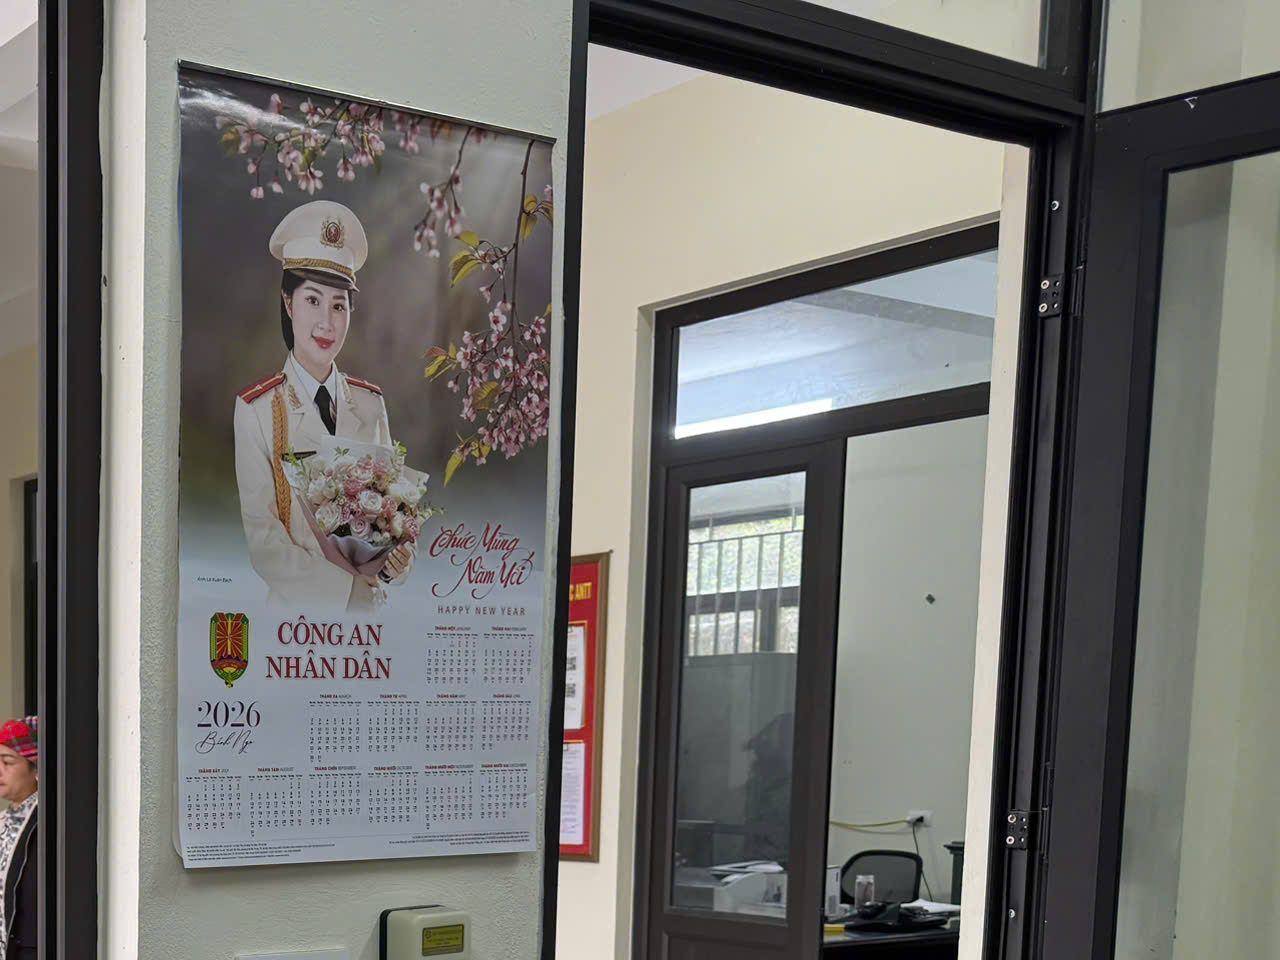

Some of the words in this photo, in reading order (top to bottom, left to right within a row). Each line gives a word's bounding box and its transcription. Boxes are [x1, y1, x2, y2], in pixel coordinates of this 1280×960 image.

[437, 605, 470, 615] HAPPY
[475, 606, 497, 616] NEW
[501, 607, 526, 616] YEAR
[277, 615, 344, 646] CÔNG
[348, 623, 383, 646] AN
[265, 649, 336, 679] NHÂN
[342, 650, 392, 679] DÂN
[196, 700, 261, 728] 2026
